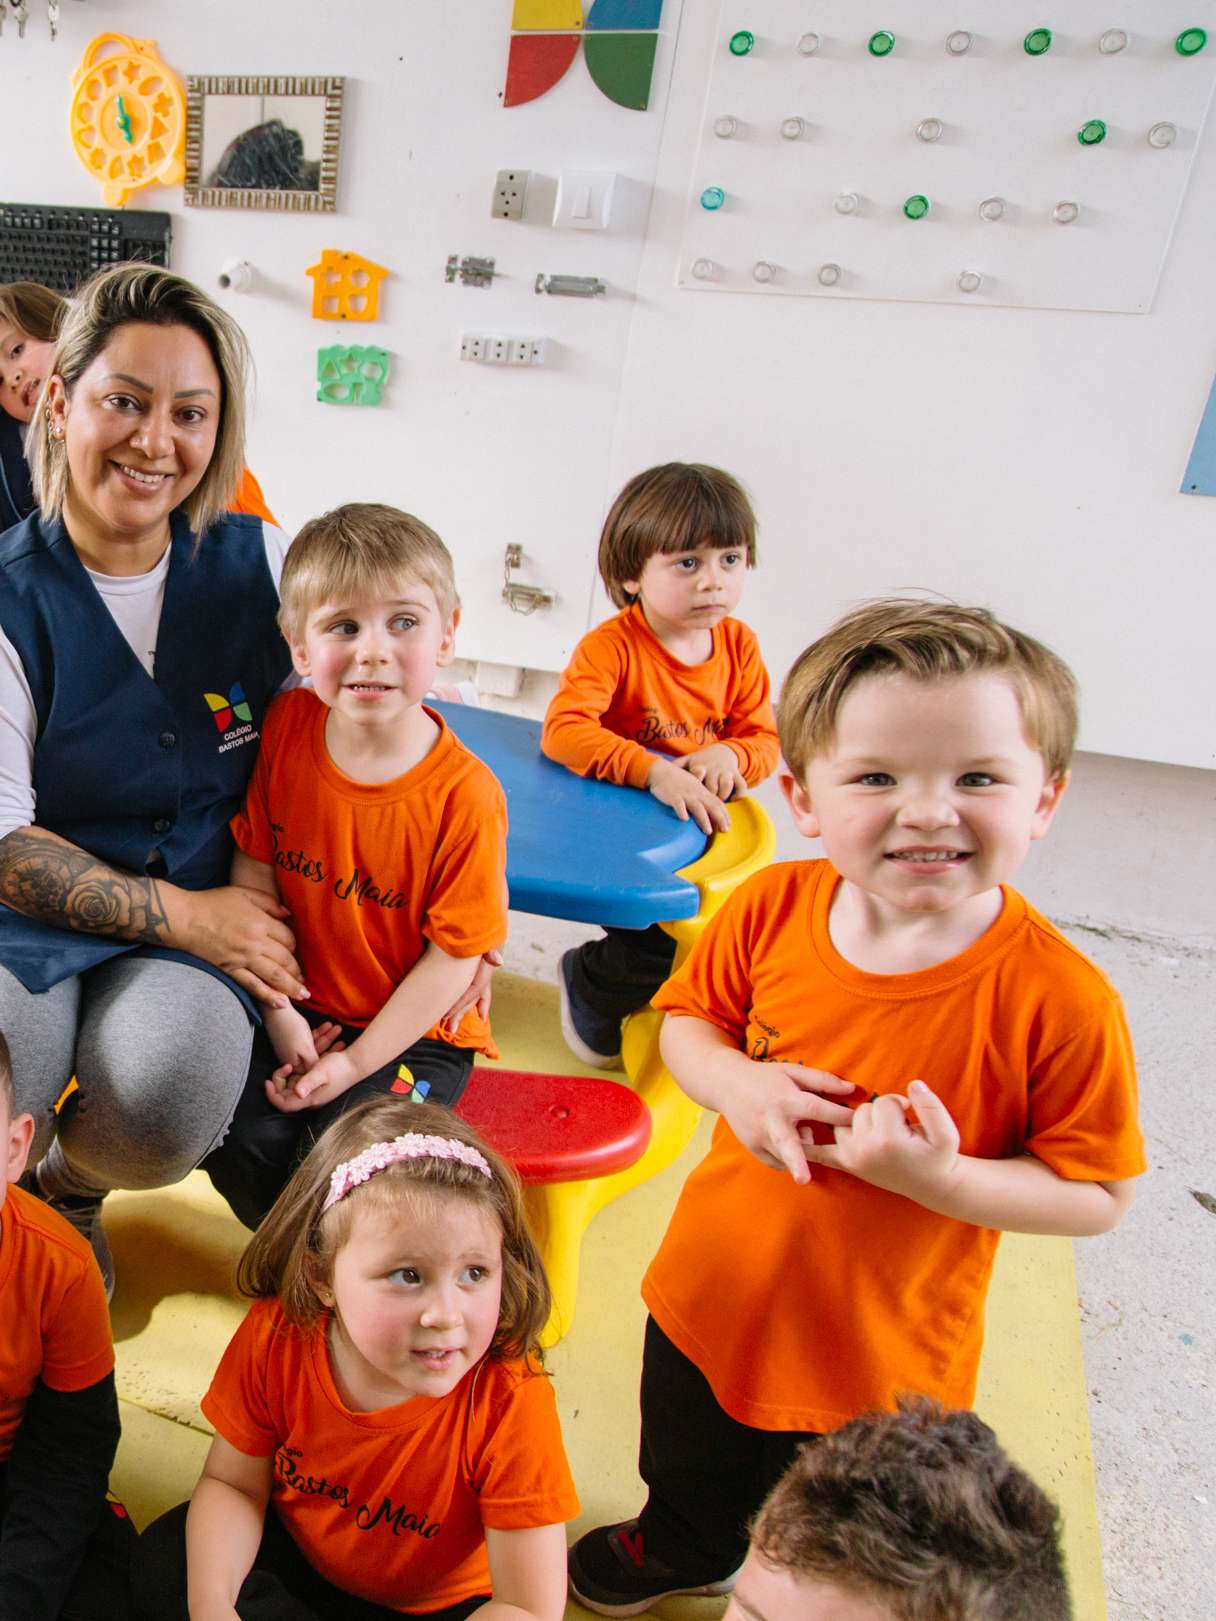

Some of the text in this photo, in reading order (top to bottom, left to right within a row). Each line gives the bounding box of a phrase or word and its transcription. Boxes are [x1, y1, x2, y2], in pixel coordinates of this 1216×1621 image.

[218, 737, 244, 753] BASTOS
[334, 868, 407, 909] Maia
[356, 1497, 440, 1539] Maia
